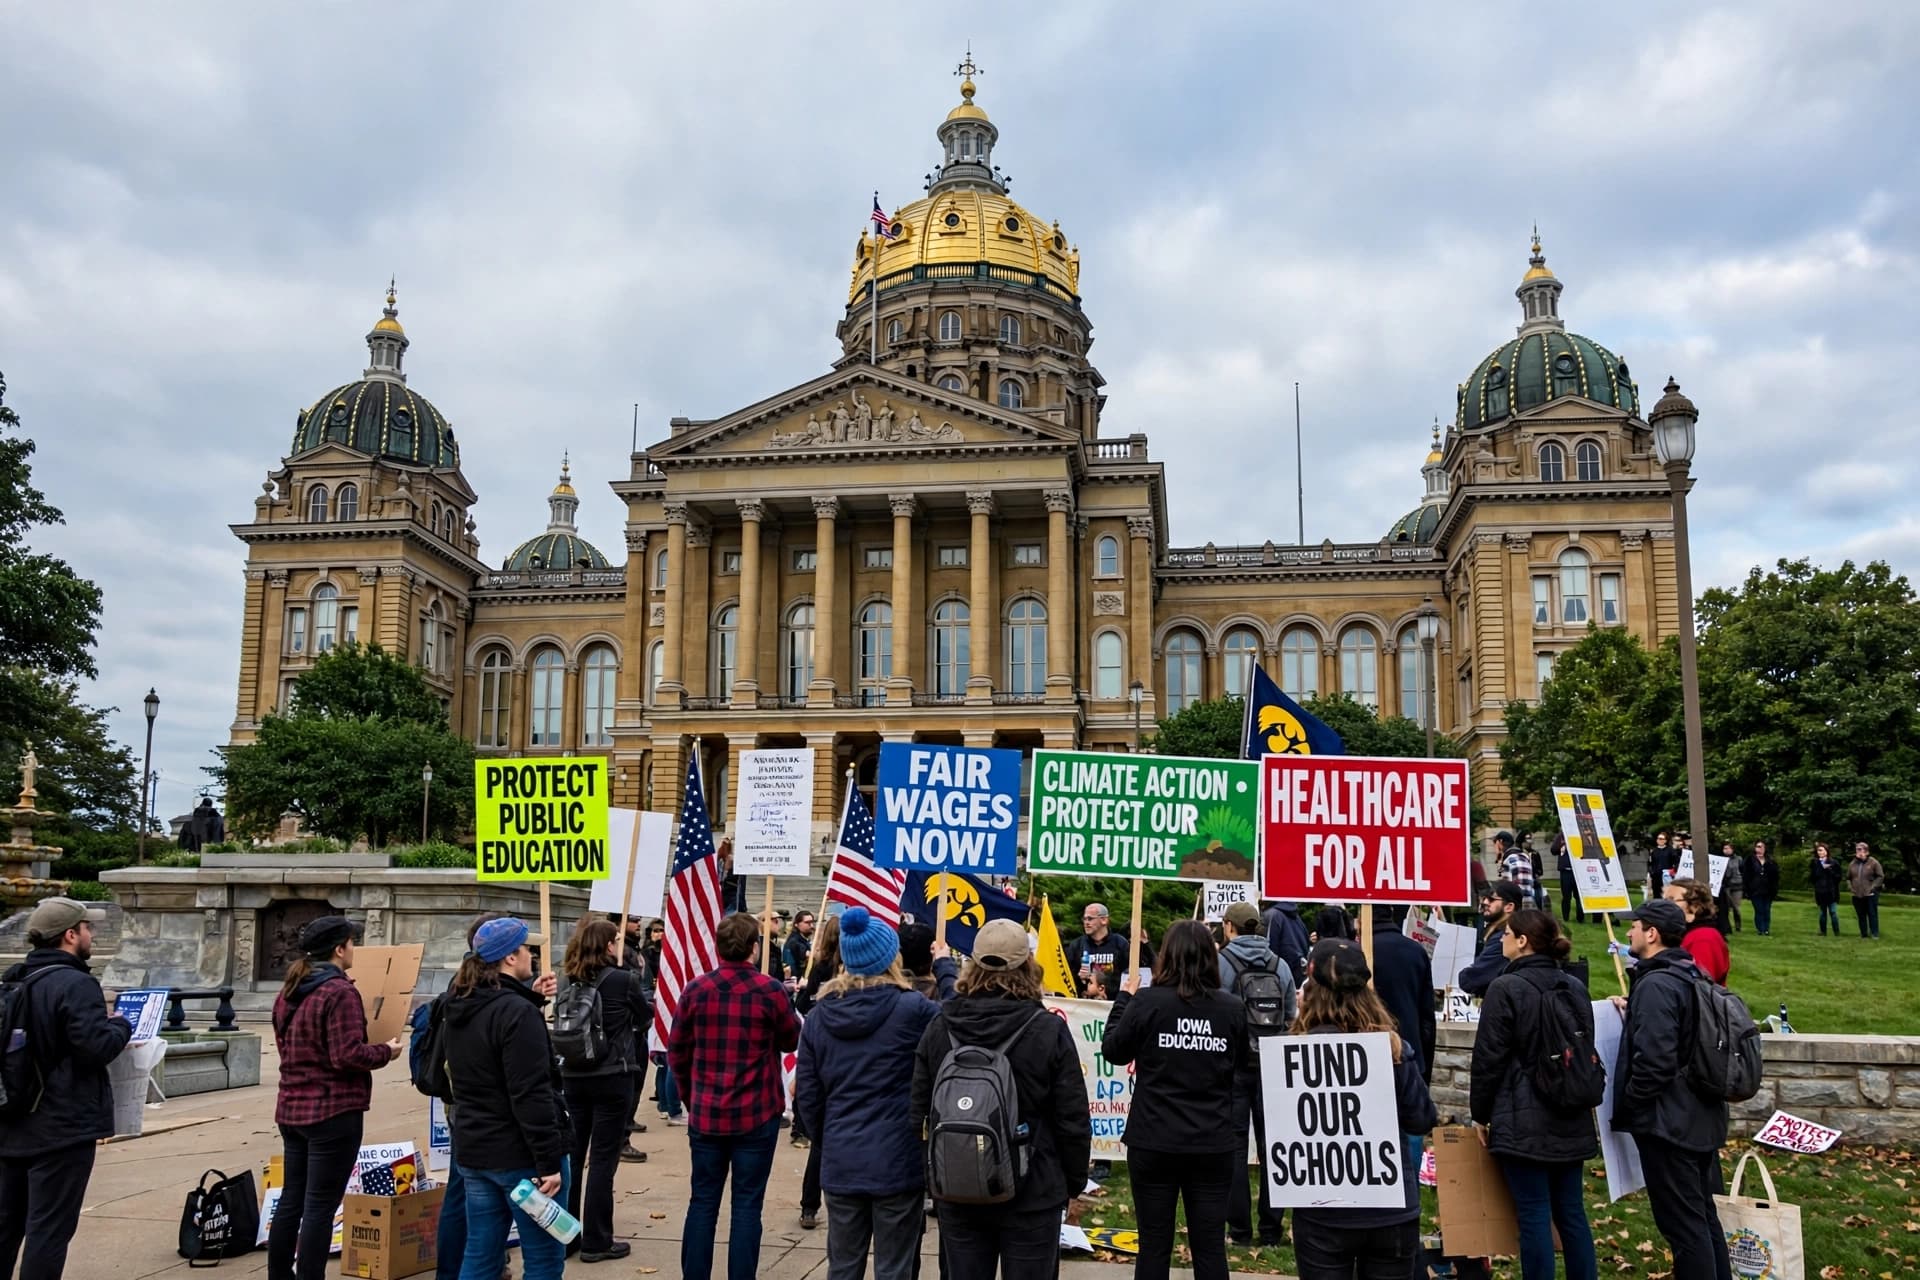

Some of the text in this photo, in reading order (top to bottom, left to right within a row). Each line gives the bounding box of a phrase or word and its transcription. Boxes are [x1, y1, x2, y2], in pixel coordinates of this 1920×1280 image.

[487, 764, 597, 798] PROTECT
[909, 750, 991, 789] FAIR
[1043, 761, 1228, 801] CLIMATE ACTION
[884, 789, 1012, 829] WAGES
[1042, 797, 1198, 835] PROTECT OUR
[1271, 769, 1460, 828] HEALTHCARE
[500, 802, 585, 835] PUBLIC
[483, 839, 604, 873] EDUCATION
[895, 828, 996, 866] NOW!
[1039, 831, 1177, 870] OUR FUTURE
[1305, 834, 1430, 890] FOR ALL
[1158, 1032, 1227, 1052] EDUCATORS
[1177, 1017, 1211, 1035] IOWA
[1284, 1043, 1368, 1088] FUND
[1298, 1093, 1363, 1136] OUR
[1272, 1141, 1397, 1186] SCHOOLS
